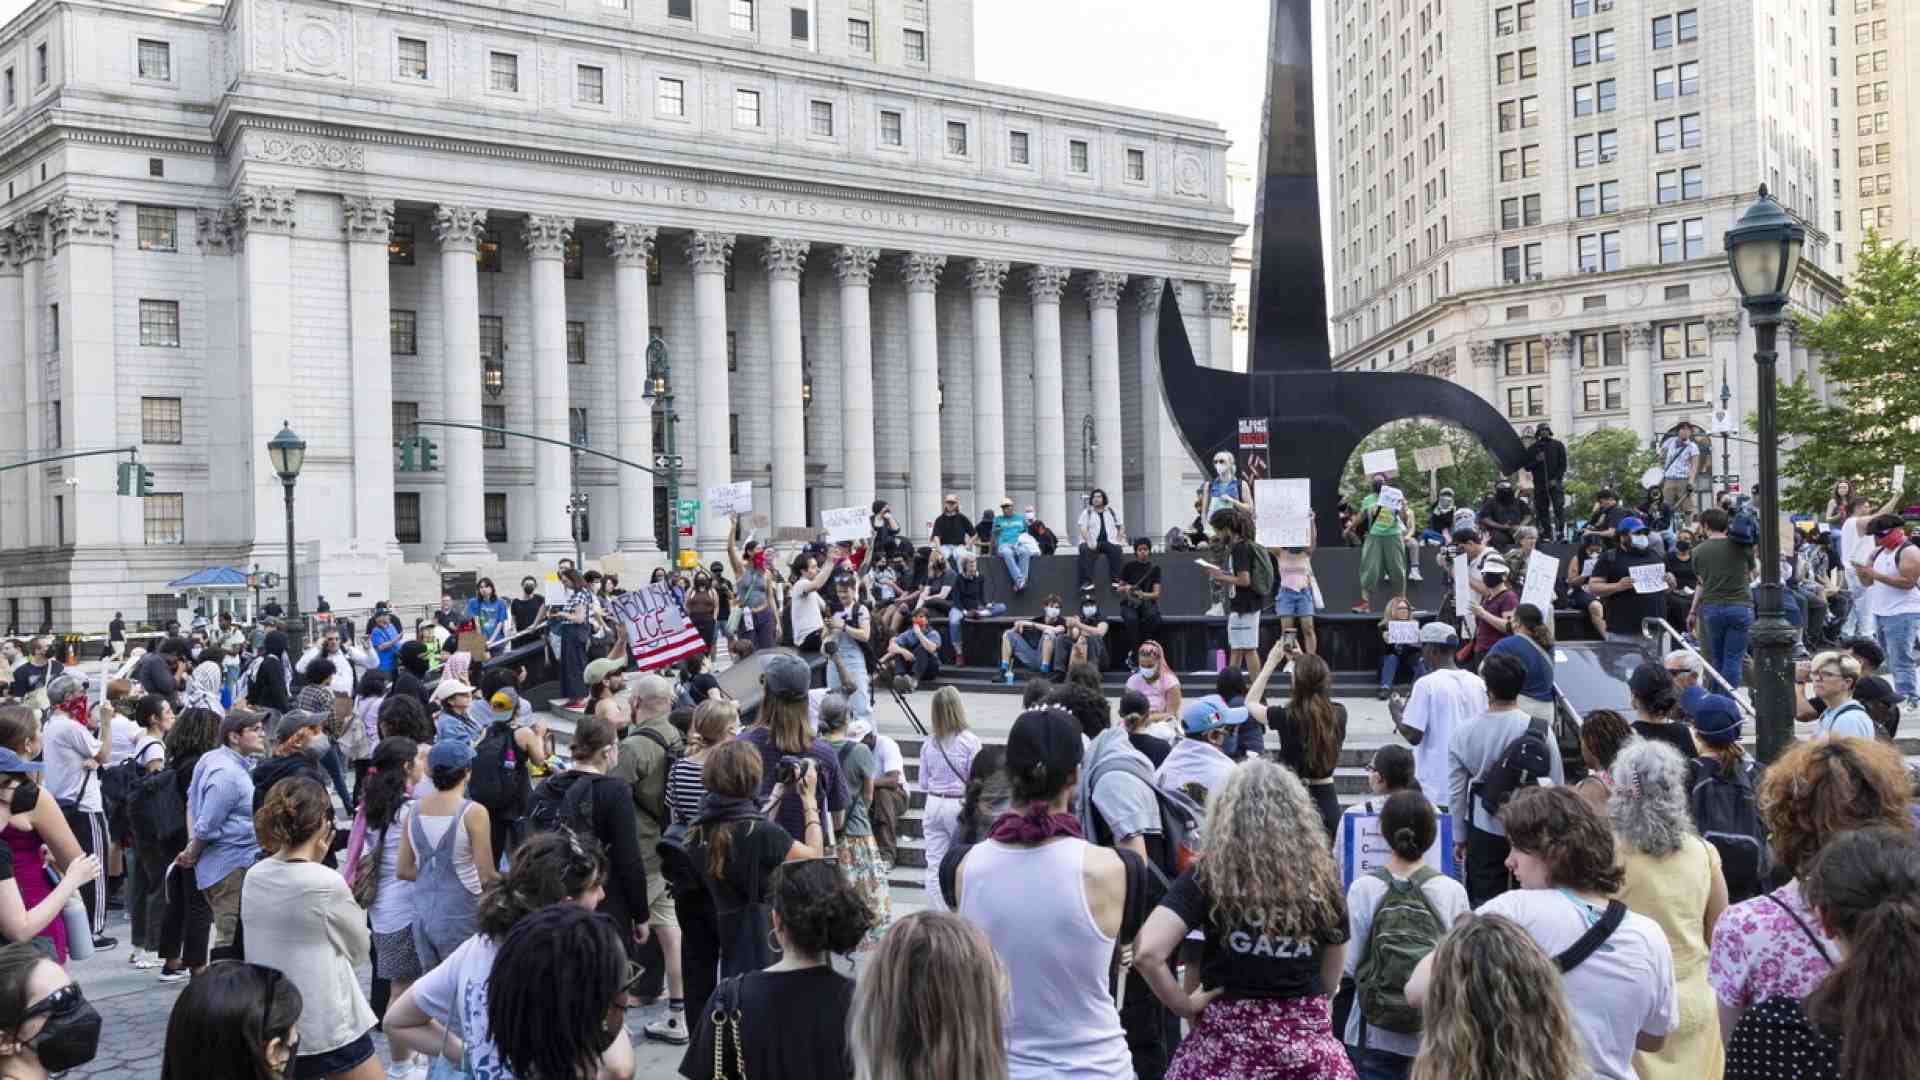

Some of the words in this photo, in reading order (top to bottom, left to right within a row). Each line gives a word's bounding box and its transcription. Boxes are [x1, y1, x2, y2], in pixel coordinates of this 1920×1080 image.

[609, 180, 709, 203] UNITED
[737, 193, 817, 216] STATES
[842, 207, 920, 230] COURT
[943, 218, 1010, 239] HOUSE
[611, 580, 673, 624] ABOLISH
[631, 607, 676, 642] ICE
[1229, 930, 1314, 958] GAZA
